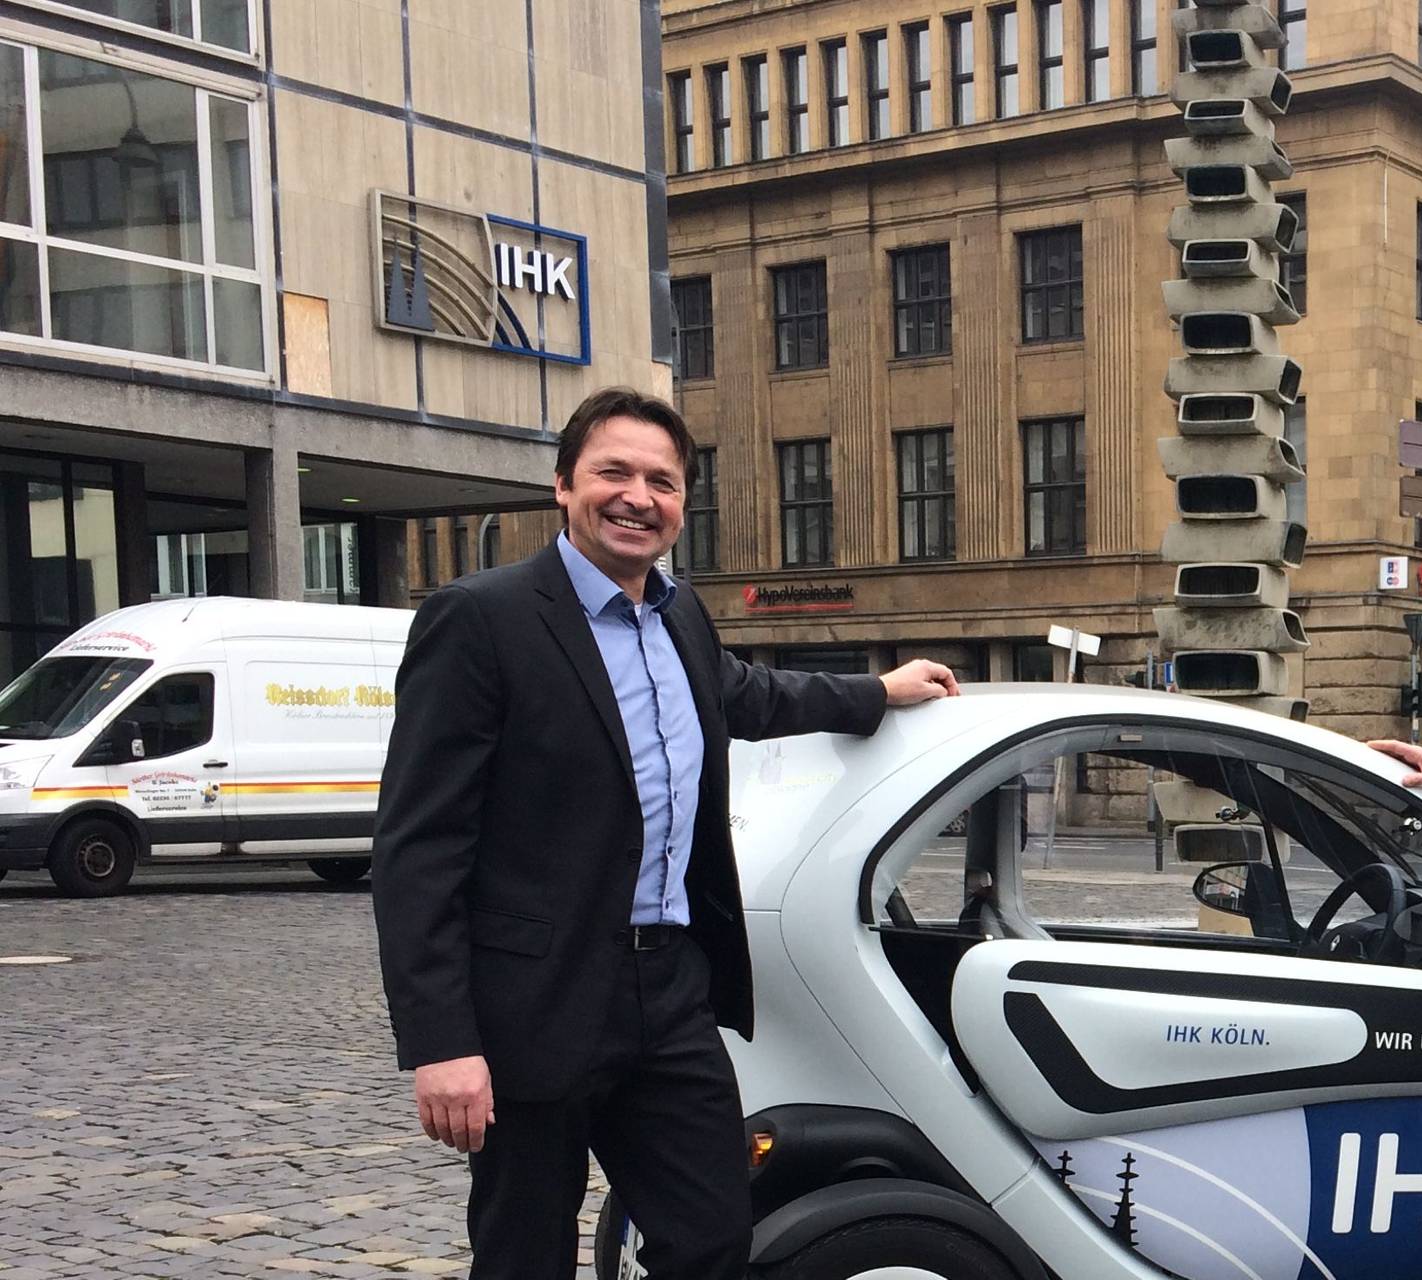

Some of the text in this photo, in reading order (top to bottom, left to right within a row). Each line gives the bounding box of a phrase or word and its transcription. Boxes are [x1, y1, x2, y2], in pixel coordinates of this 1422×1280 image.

[497, 242, 576, 300] IHK
[757, 583, 854, 606] HypoVereinsbank
[1166, 1023, 1270, 1046] IHK KÖLN.
[1375, 1031, 1413, 1051] WIR
